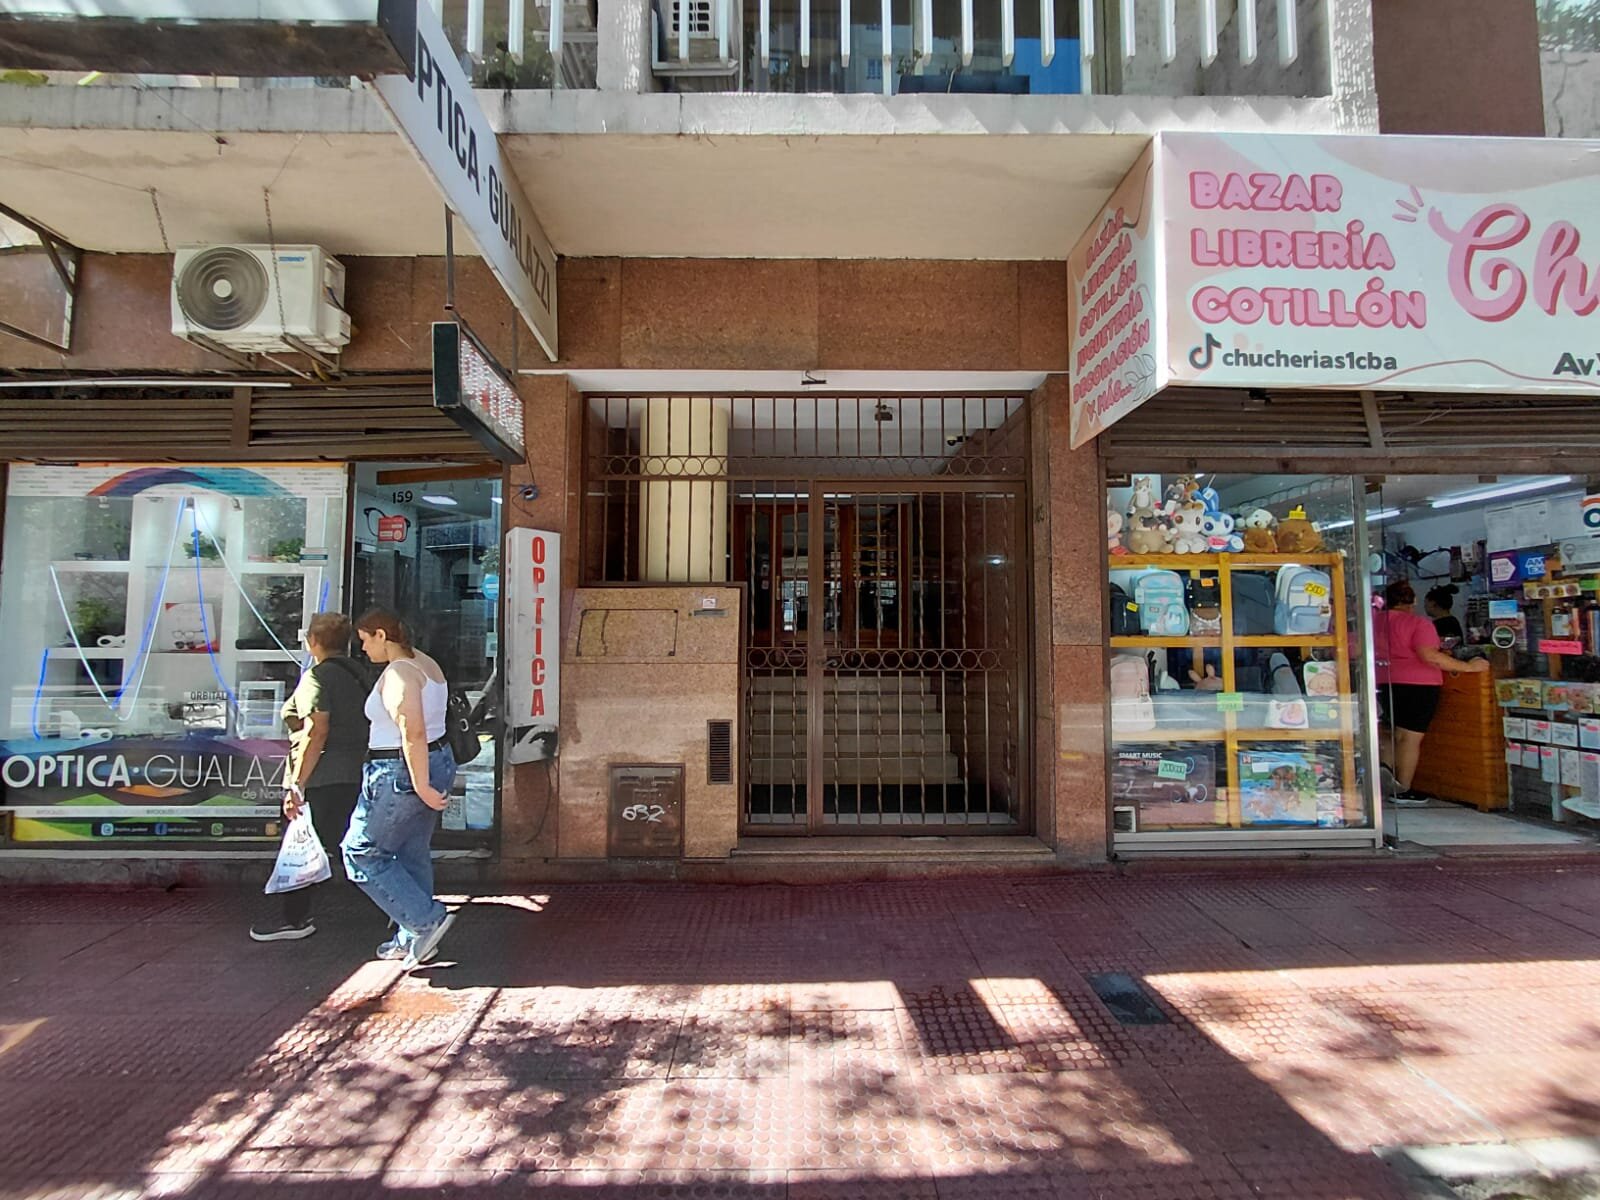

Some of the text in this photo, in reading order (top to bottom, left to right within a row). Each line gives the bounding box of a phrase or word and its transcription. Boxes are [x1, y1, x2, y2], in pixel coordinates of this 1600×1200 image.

[408, 29, 480, 196] PTICA
[488, 164, 550, 315] GUALAZZI
[1189, 171, 1343, 212] BAZAR
[1087, 207, 1124, 269] BAZAR
[1191, 219, 1395, 270] LIBRERÍA
[1427, 202, 1600, 322] Ch
[1082, 233, 1132, 305] LIBRERÍA
[1079, 260, 1137, 337] COTILLÓN
[1192, 276, 1427, 328] COTILLÓN
[1073, 318, 1150, 404] DECORACIÓN
[1076, 290, 1143, 376] JUGUETERÍA
[1222, 348, 1398, 371] chucherias1cba
[392, 490, 413, 504] 159
[530, 536, 546, 717] OPTICA
[190, 691, 227, 701] ORBITAL
[2, 754, 131, 788] OPTICA
[241, 788, 257, 800] de
